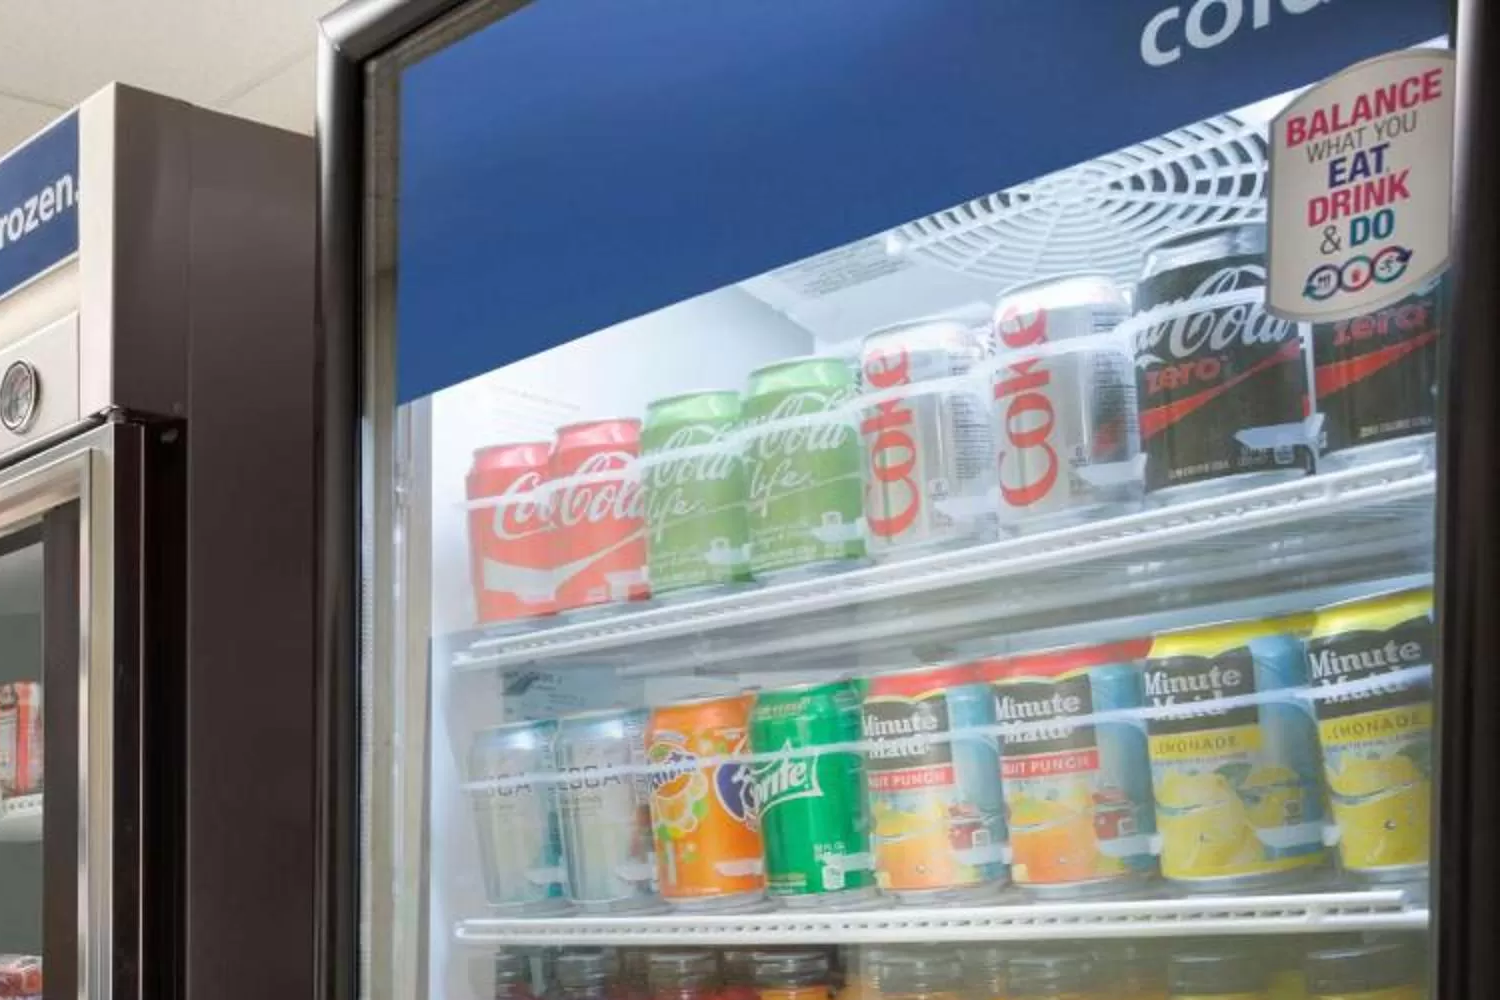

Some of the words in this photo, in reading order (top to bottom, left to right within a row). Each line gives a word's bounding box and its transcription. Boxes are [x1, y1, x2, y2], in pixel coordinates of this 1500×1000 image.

[1140, 0, 1330, 67] co
[1286, 68, 1443, 148] BALANCE
[1306, 127, 1369, 164] WHAT
[1373, 111, 1418, 143] YOU
[1328, 143, 1390, 189] EAT
[1307, 169, 1412, 228] DRINK
[1319, 225, 1342, 255] &
[1349, 208, 1395, 247] DO
[1145, 356, 1222, 393] zero
[995, 305, 1060, 508] Coke
[862, 344, 921, 539] Coke
[1309, 639, 1421, 679] Minute
[1144, 665, 1242, 696] Minute
[862, 710, 938, 737] Minute
[995, 693, 1081, 722] Minute
[1327, 711, 1420, 741] EMONADE
[1155, 735, 1238, 754] EMONADE
[891, 770, 945, 786] PUNCH
[1031, 757, 1092, 774] PUNCH
